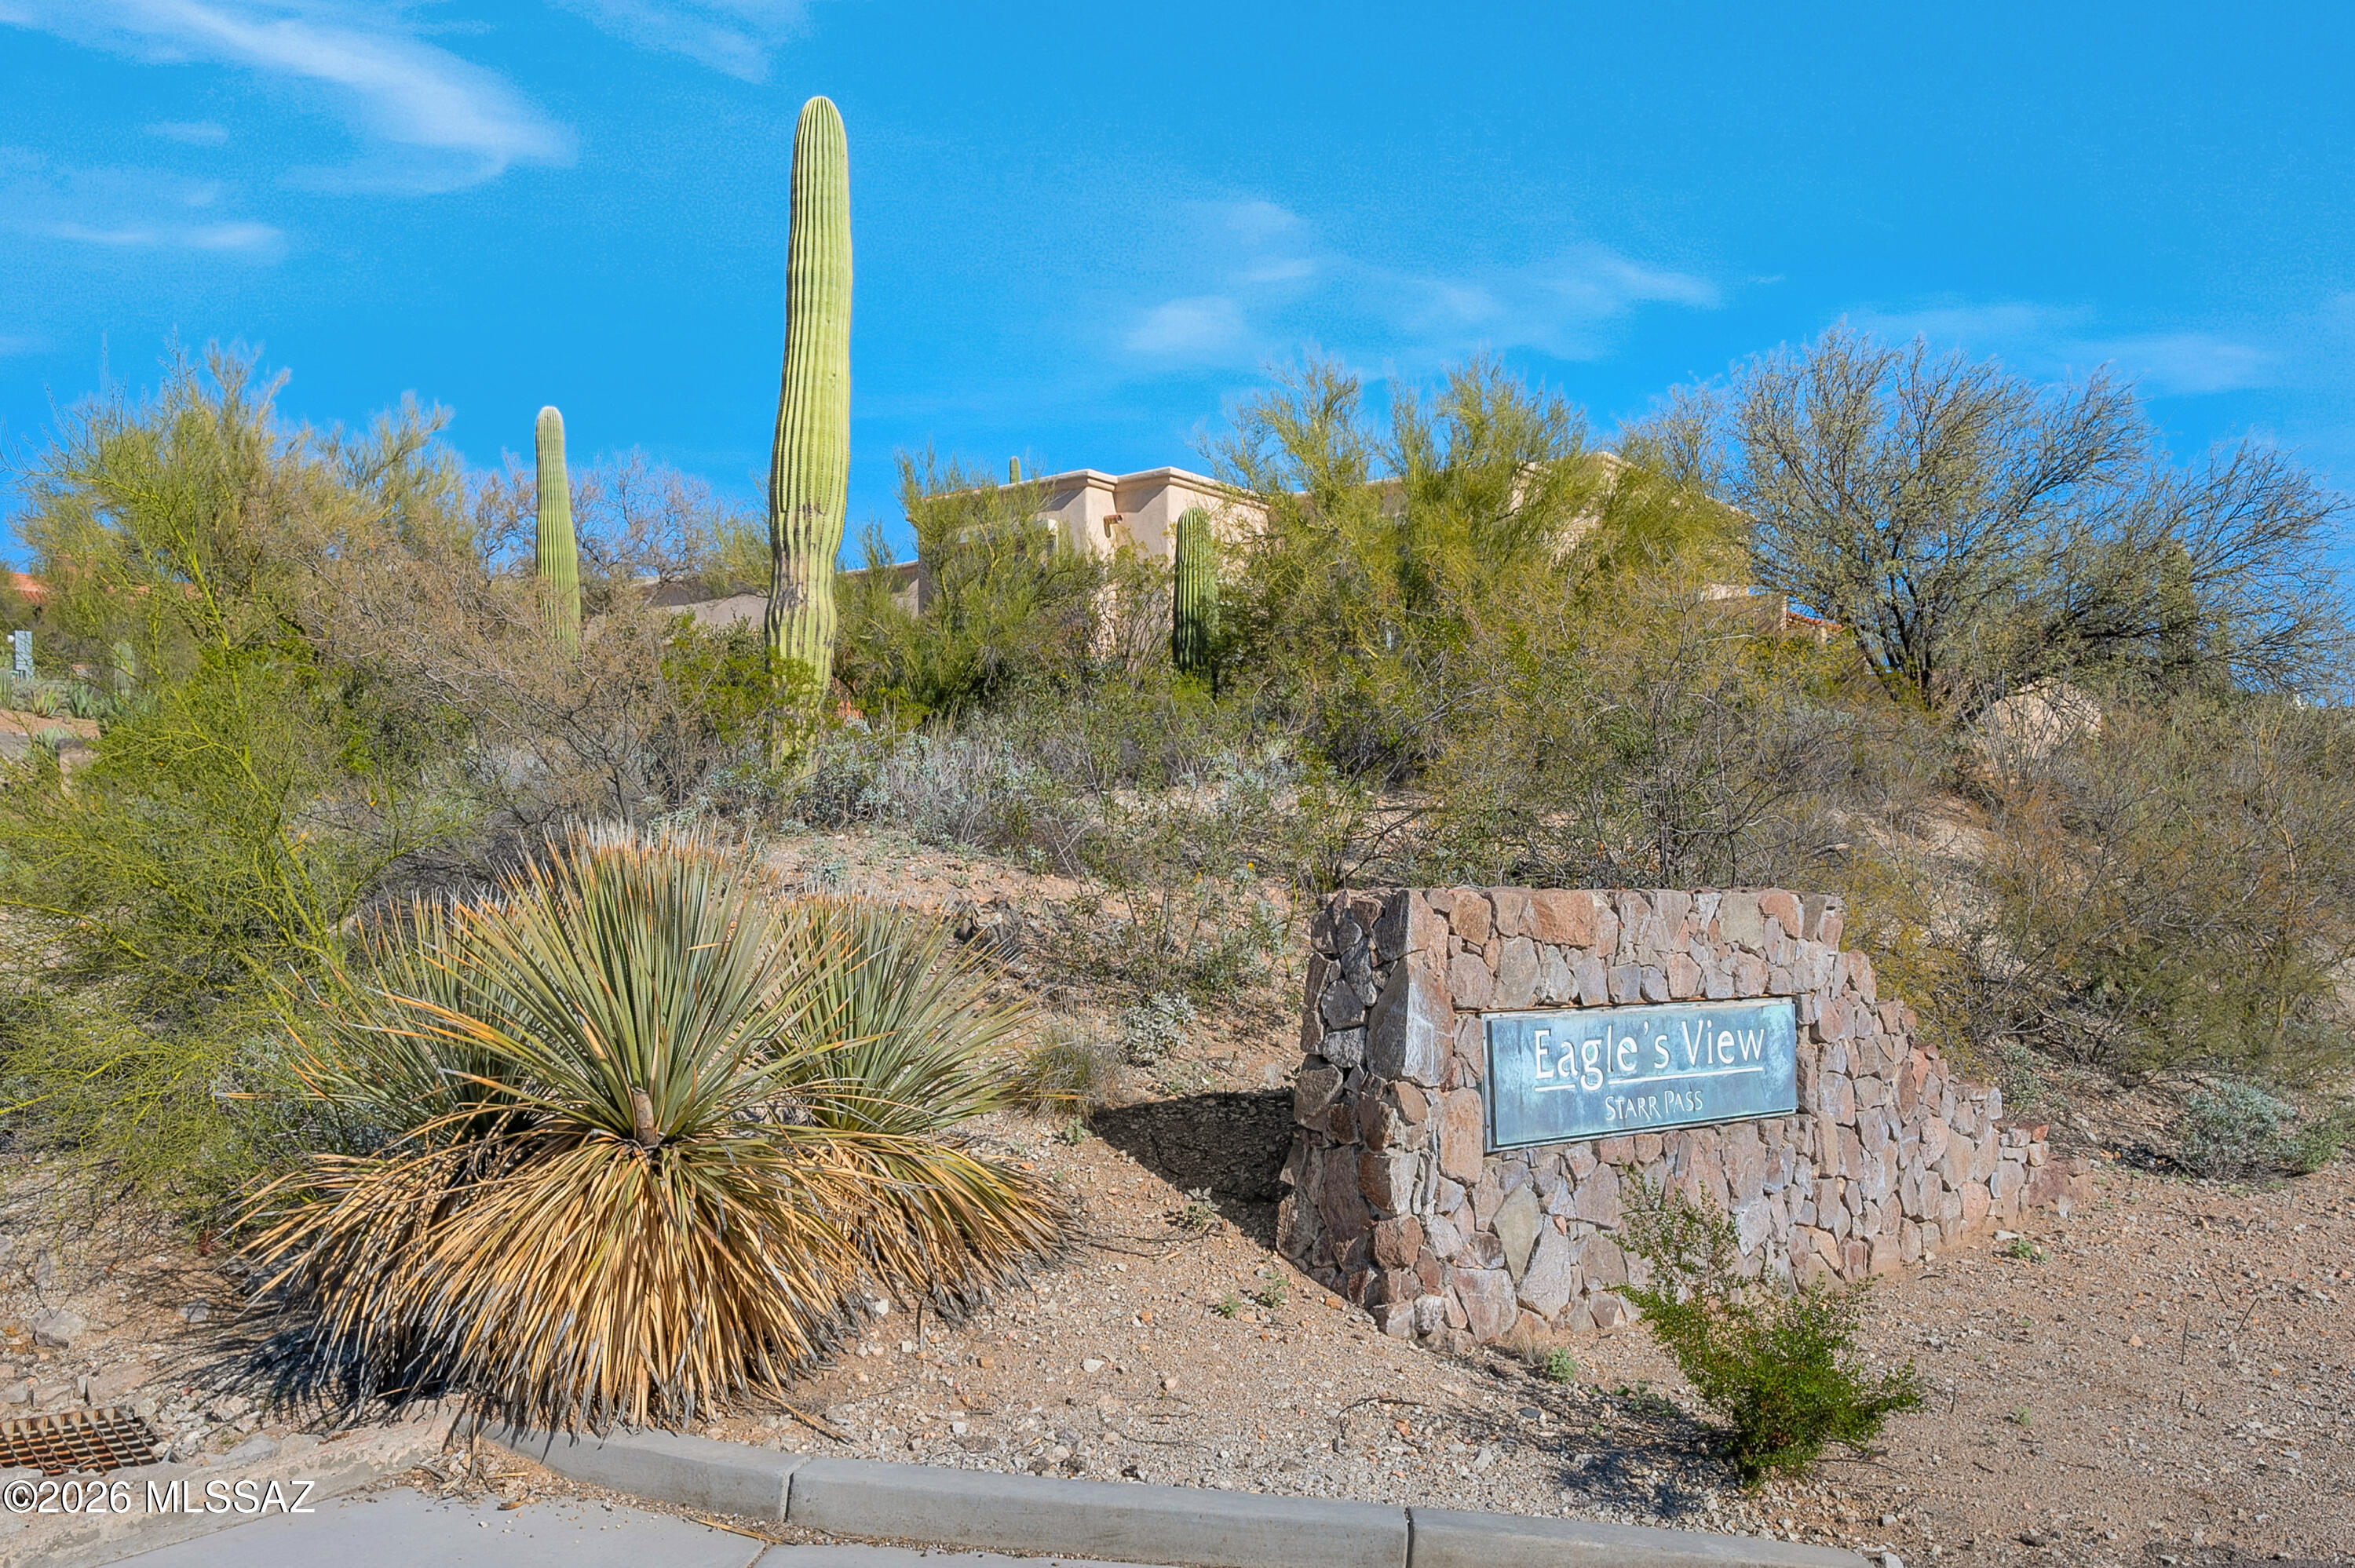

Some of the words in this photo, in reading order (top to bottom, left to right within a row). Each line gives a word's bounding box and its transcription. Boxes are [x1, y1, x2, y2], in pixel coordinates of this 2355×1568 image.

[1534, 1020, 1670, 1091] Eagle's
[1681, 1019, 1765, 1066] View
[1605, 1095, 1663, 1121] STARR
[1664, 1089, 1703, 1114] PASS
